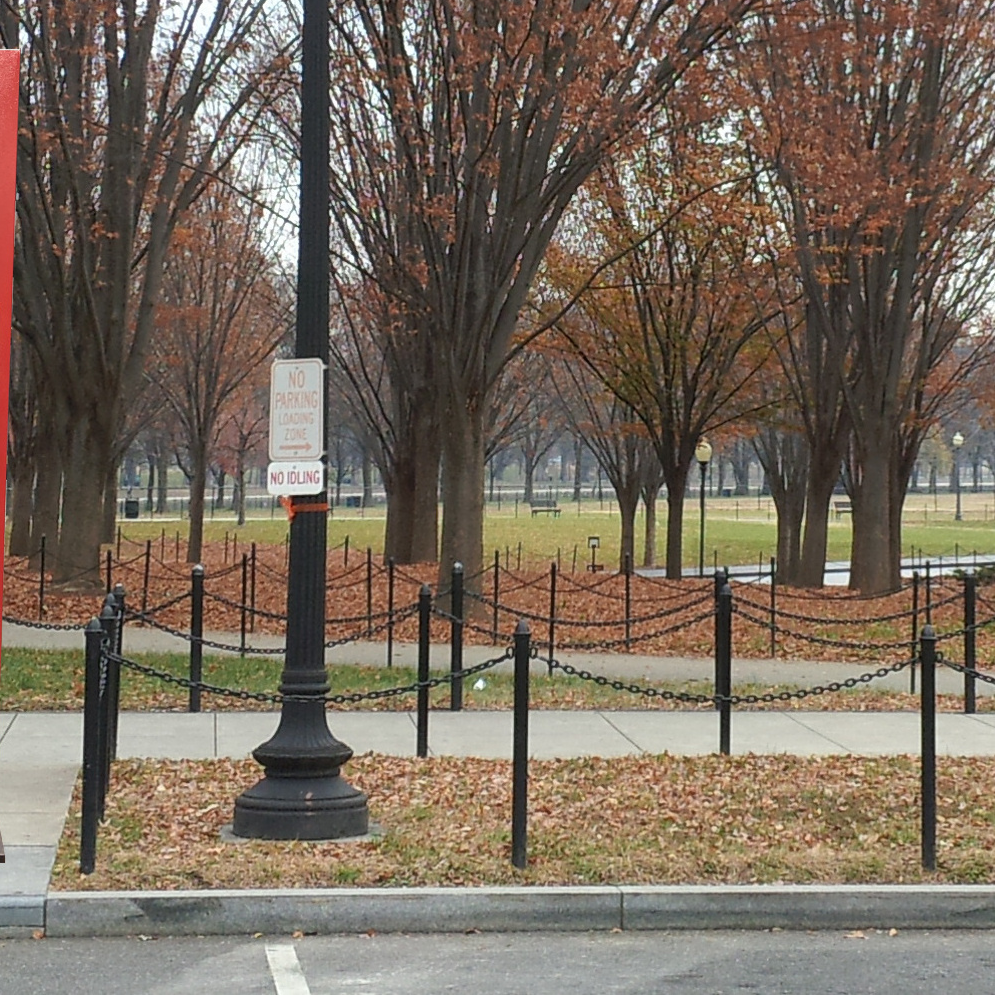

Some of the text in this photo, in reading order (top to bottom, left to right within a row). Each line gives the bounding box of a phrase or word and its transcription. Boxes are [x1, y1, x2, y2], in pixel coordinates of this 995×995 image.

[289, 370, 305, 388] NO
[275, 391, 318, 409] PARKING
[279, 412, 314, 425] LOADING
[285, 428, 307, 441] ZONE
[271, 470, 320, 485] NO IDLING
